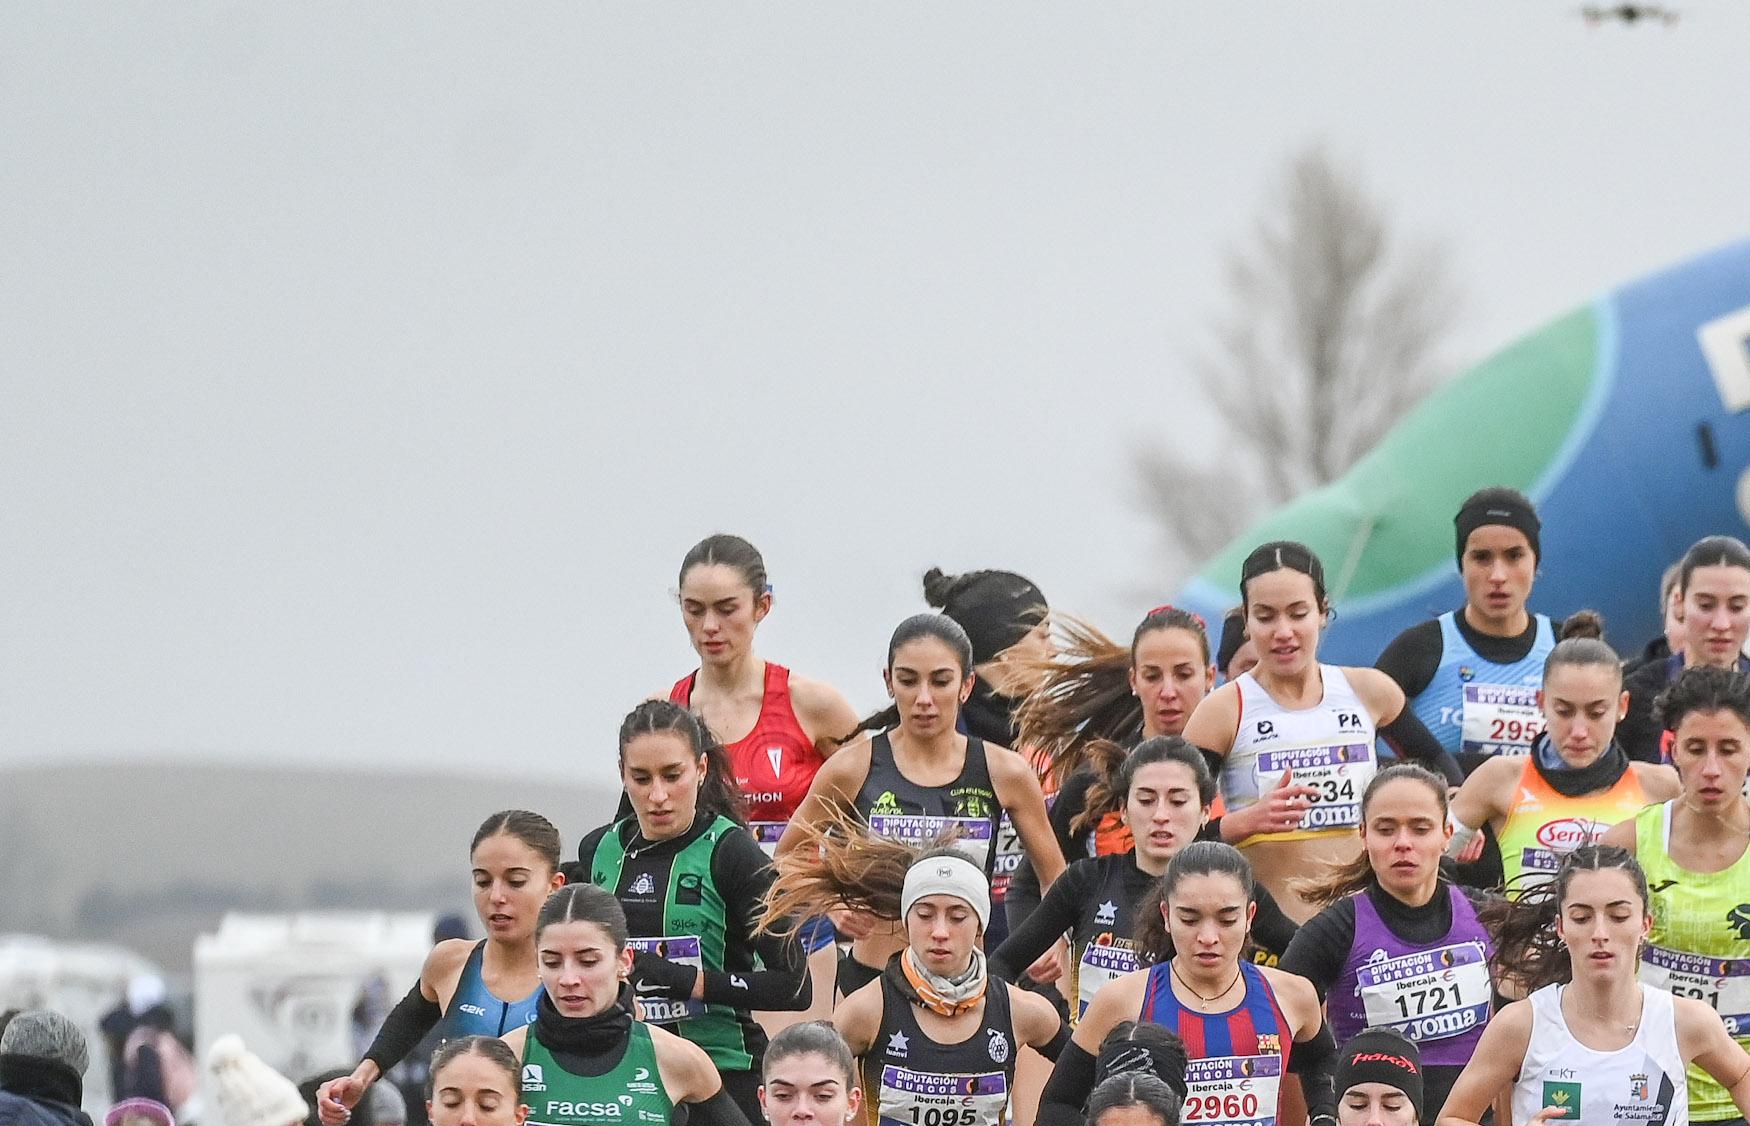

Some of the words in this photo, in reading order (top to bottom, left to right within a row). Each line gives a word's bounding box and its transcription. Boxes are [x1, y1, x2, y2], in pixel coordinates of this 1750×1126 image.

[1490, 719, 1547, 740] 295
[743, 792, 783, 803] THON
[1302, 778, 1354, 803] 34
[1091, 949, 1140, 962] DIPUTAC
[1091, 957, 1140, 970] BURGO
[1371, 954, 1432, 975] DIPUTACIÓN
[1372, 963, 1435, 984] BURGOS
[1668, 972, 1709, 986] Ibercaja
[1396, 975, 1437, 990] Ibercaja
[1394, 984, 1462, 1018] 1721
[459, 1003, 486, 1017] 42K
[1410, 1009, 1477, 1041] Joma
[1187, 1060, 1233, 1072] UTACIÓN
[896, 1071, 958, 1086] DIPUTACIÓN
[1184, 1071, 1233, 1081] URGOS
[895, 1082, 957, 1094] BURGOS
[1192, 1082, 1233, 1092] Ibercaja
[914, 1095, 956, 1105] Ibercaja
[1186, 1093, 1258, 1120] 2960
[546, 1100, 622, 1117] Facsa
[908, 1106, 977, 1126] 1095
